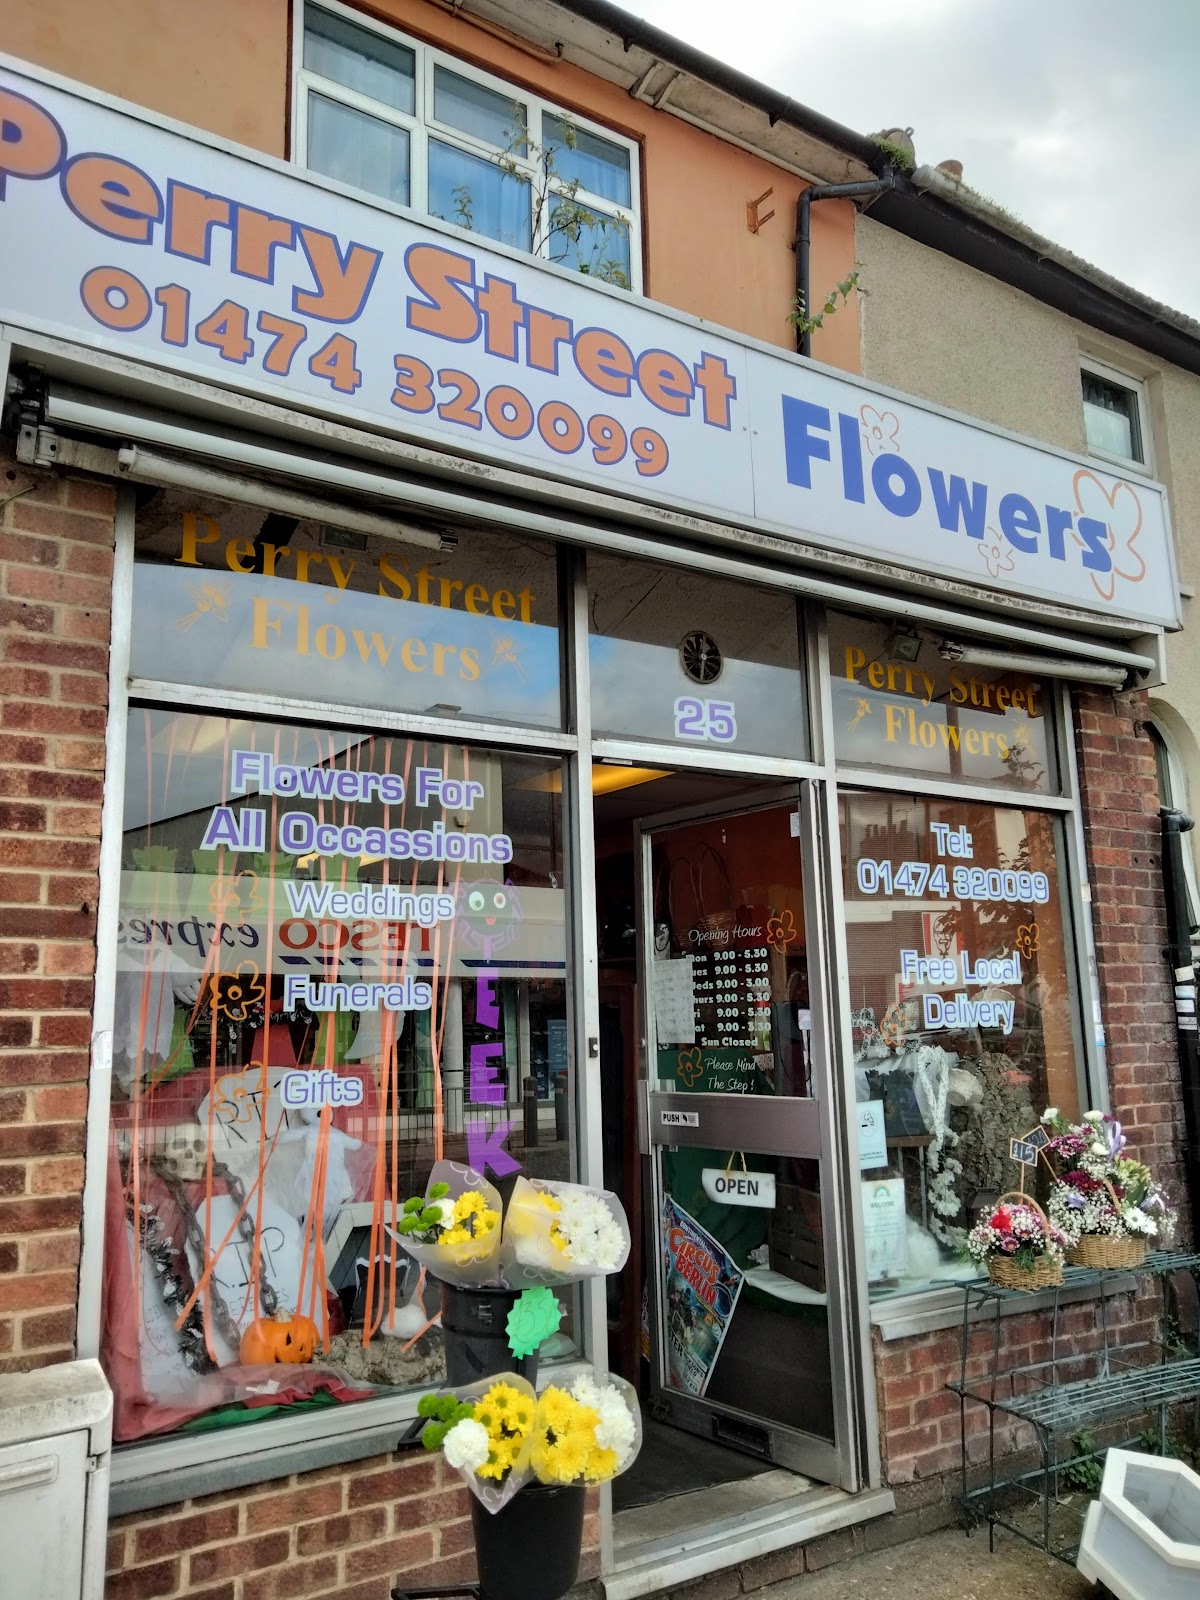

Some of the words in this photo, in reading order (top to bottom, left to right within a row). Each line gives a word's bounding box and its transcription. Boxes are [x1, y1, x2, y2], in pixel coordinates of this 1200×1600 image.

[0, 87, 383, 324] Perry
[404, 242, 737, 431] Street
[80, 266, 361, 395] 01474
[391, 353, 669, 477] 320099
[781, 393, 1113, 573] Flowers
[174, 511, 357, 604] Perry
[378, 552, 537, 625] Street
[249, 597, 481, 682] Flowers
[844, 645, 936, 705] Perry
[949, 664, 1038, 718] Street
[674, 697, 737, 743] 25
[884, 704, 1010, 759] Flowers
[231, 750, 404, 804] Flowers
[415, 767, 484, 811] For
[200, 806, 266, 852] All
[279, 812, 513, 864] Occassions
[930, 822, 974, 858] Tel:
[857, 858, 949, 898] 01474
[953, 866, 1049, 903] 320099
[283, 881, 455, 927] Weddings
[688, 929, 729, 946] Opening
[732, 926, 762, 938] Hours
[714, 951, 735, 960] 9.00
[744, 948, 767, 959] 5.30
[715, 965, 736, 975] 9.00
[745, 962, 768, 973] 5.30
[716, 979, 738, 989] 9.00
[901, 949, 958, 985] Free
[961, 950, 1023, 985] Local
[283, 974, 432, 1012] Funerals
[716, 993, 738, 1003] 9.00
[717, 1008, 739, 1017] 9.00
[717, 1022, 739, 1032] 9.00
[923, 993, 1015, 1035] Delivery
[701, 1037, 720, 1046] Sun
[722, 1037, 758, 1047] Closed
[704, 1058, 734, 1071] Please
[736, 1058, 756, 1072] Mind
[708, 1077, 725, 1090] The
[280, 1070, 363, 1108] Gifts
[662, 1113, 680, 1123] PUSH
[714, 1176, 760, 1197] OPEN
[669, 1227, 721, 1286] CIRCUS
[675, 1251, 718, 1308] BERLIN
